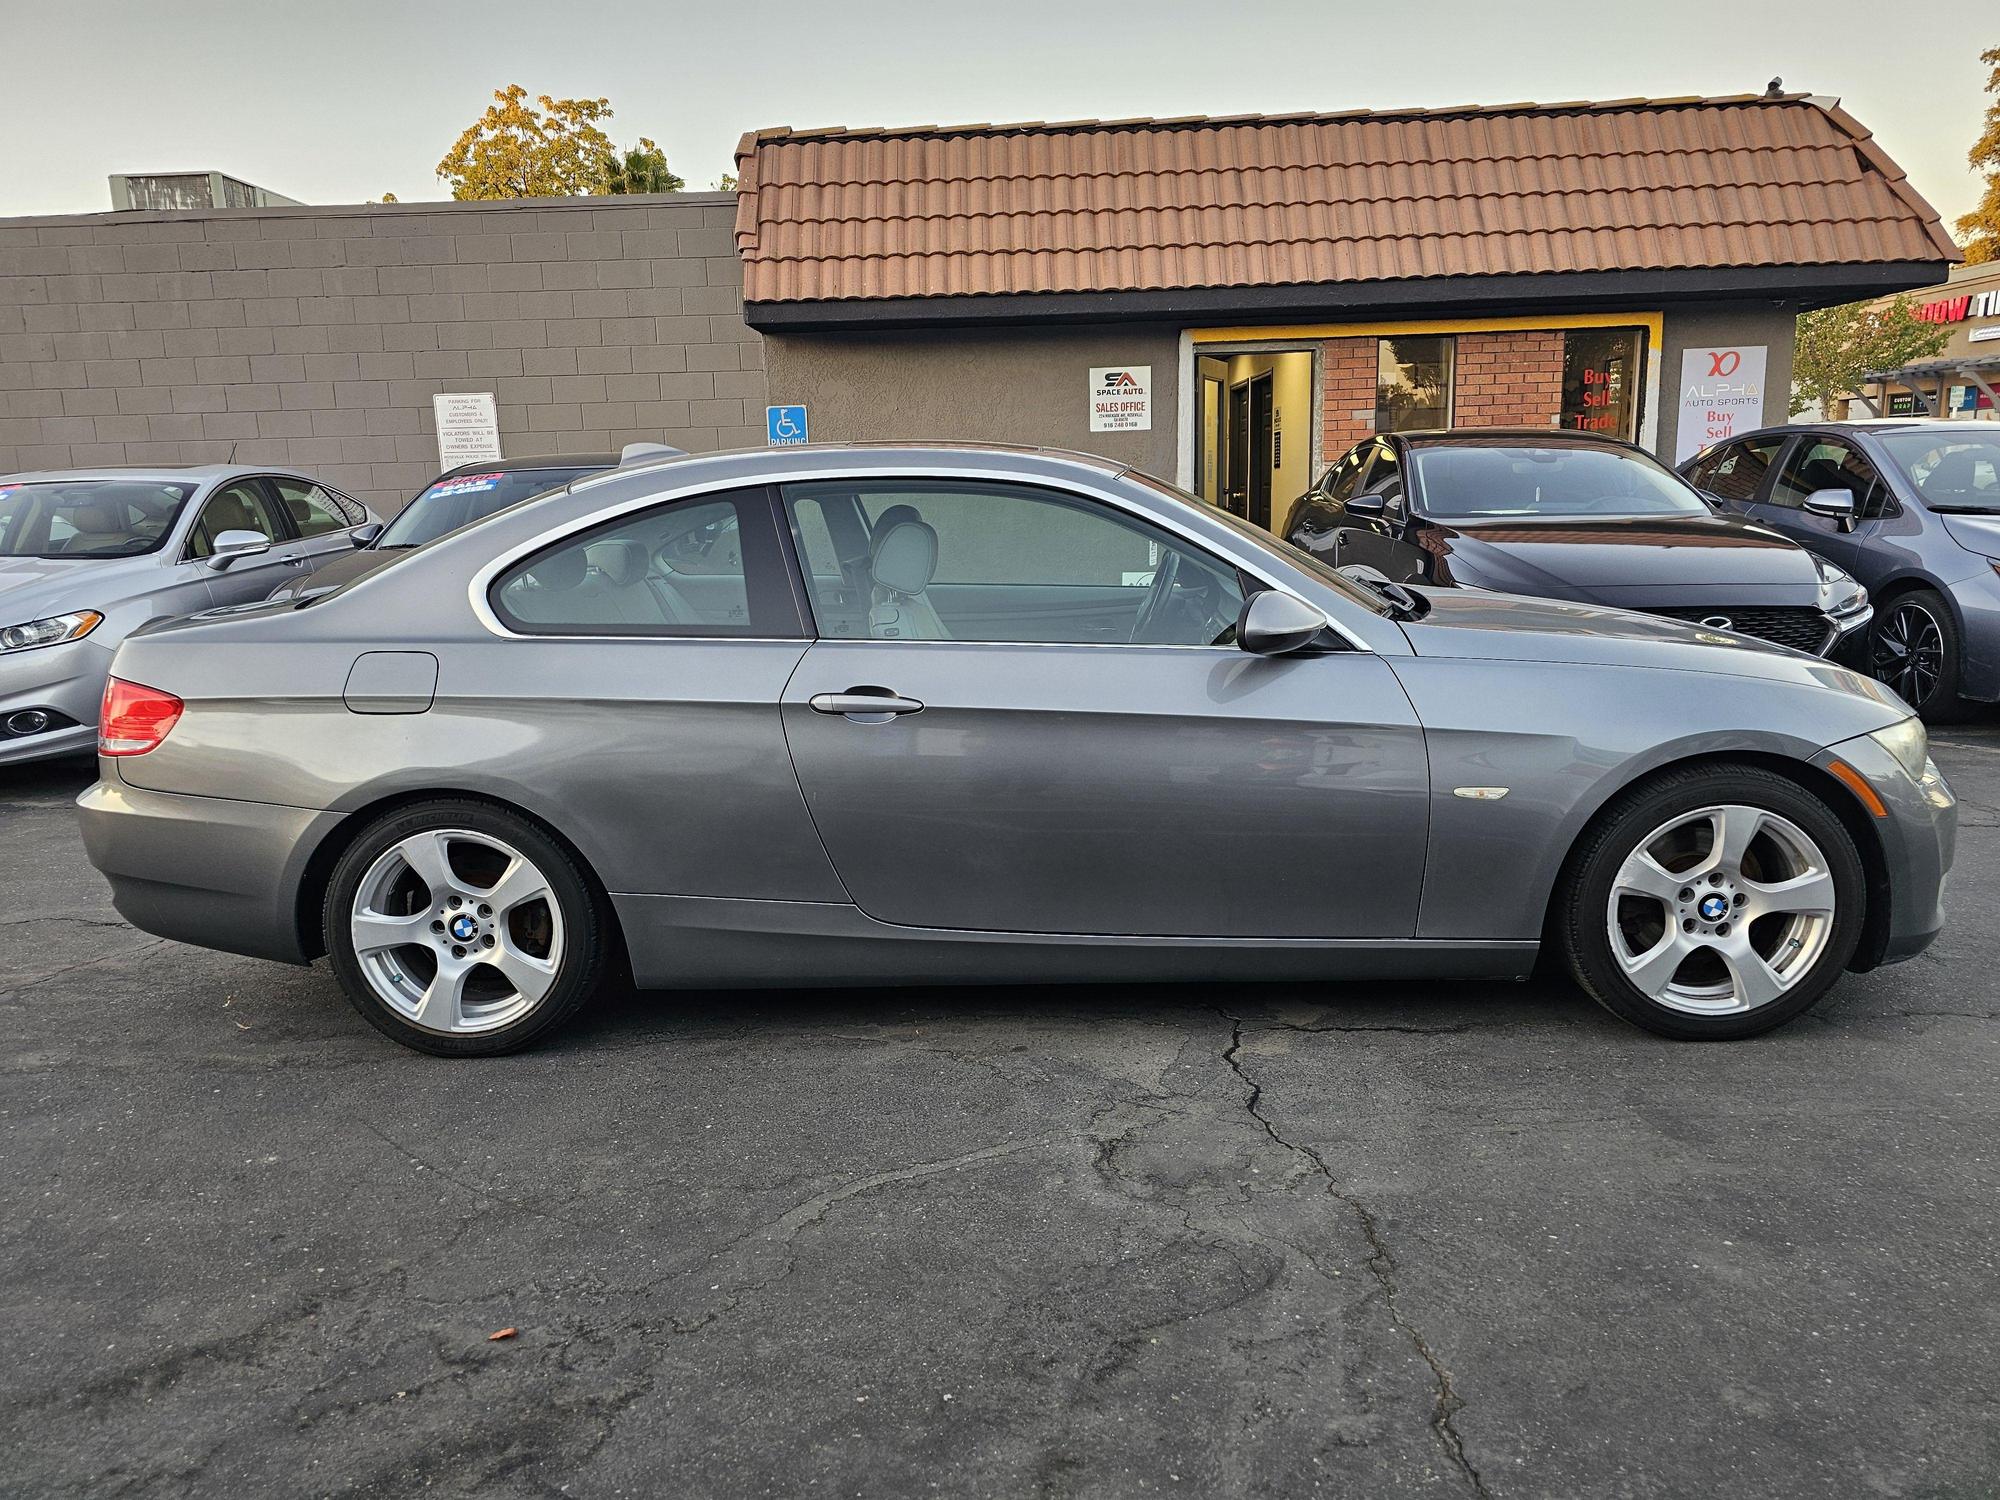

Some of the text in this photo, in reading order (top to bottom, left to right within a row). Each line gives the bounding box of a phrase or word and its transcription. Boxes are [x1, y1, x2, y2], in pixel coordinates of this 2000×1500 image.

[1686, 383, 1758, 398] ALPHA
[1583, 390, 1610, 407] Sell
[1685, 397, 1758, 407] AUTO SPORTS
[1096, 401, 1146, 413] SALES OFFICE
[1574, 412, 1617, 430] Trade
[1707, 411, 1734, 425] Buy
[1706, 426, 1732, 438] Sell
[771, 438, 806, 447] PARKING
